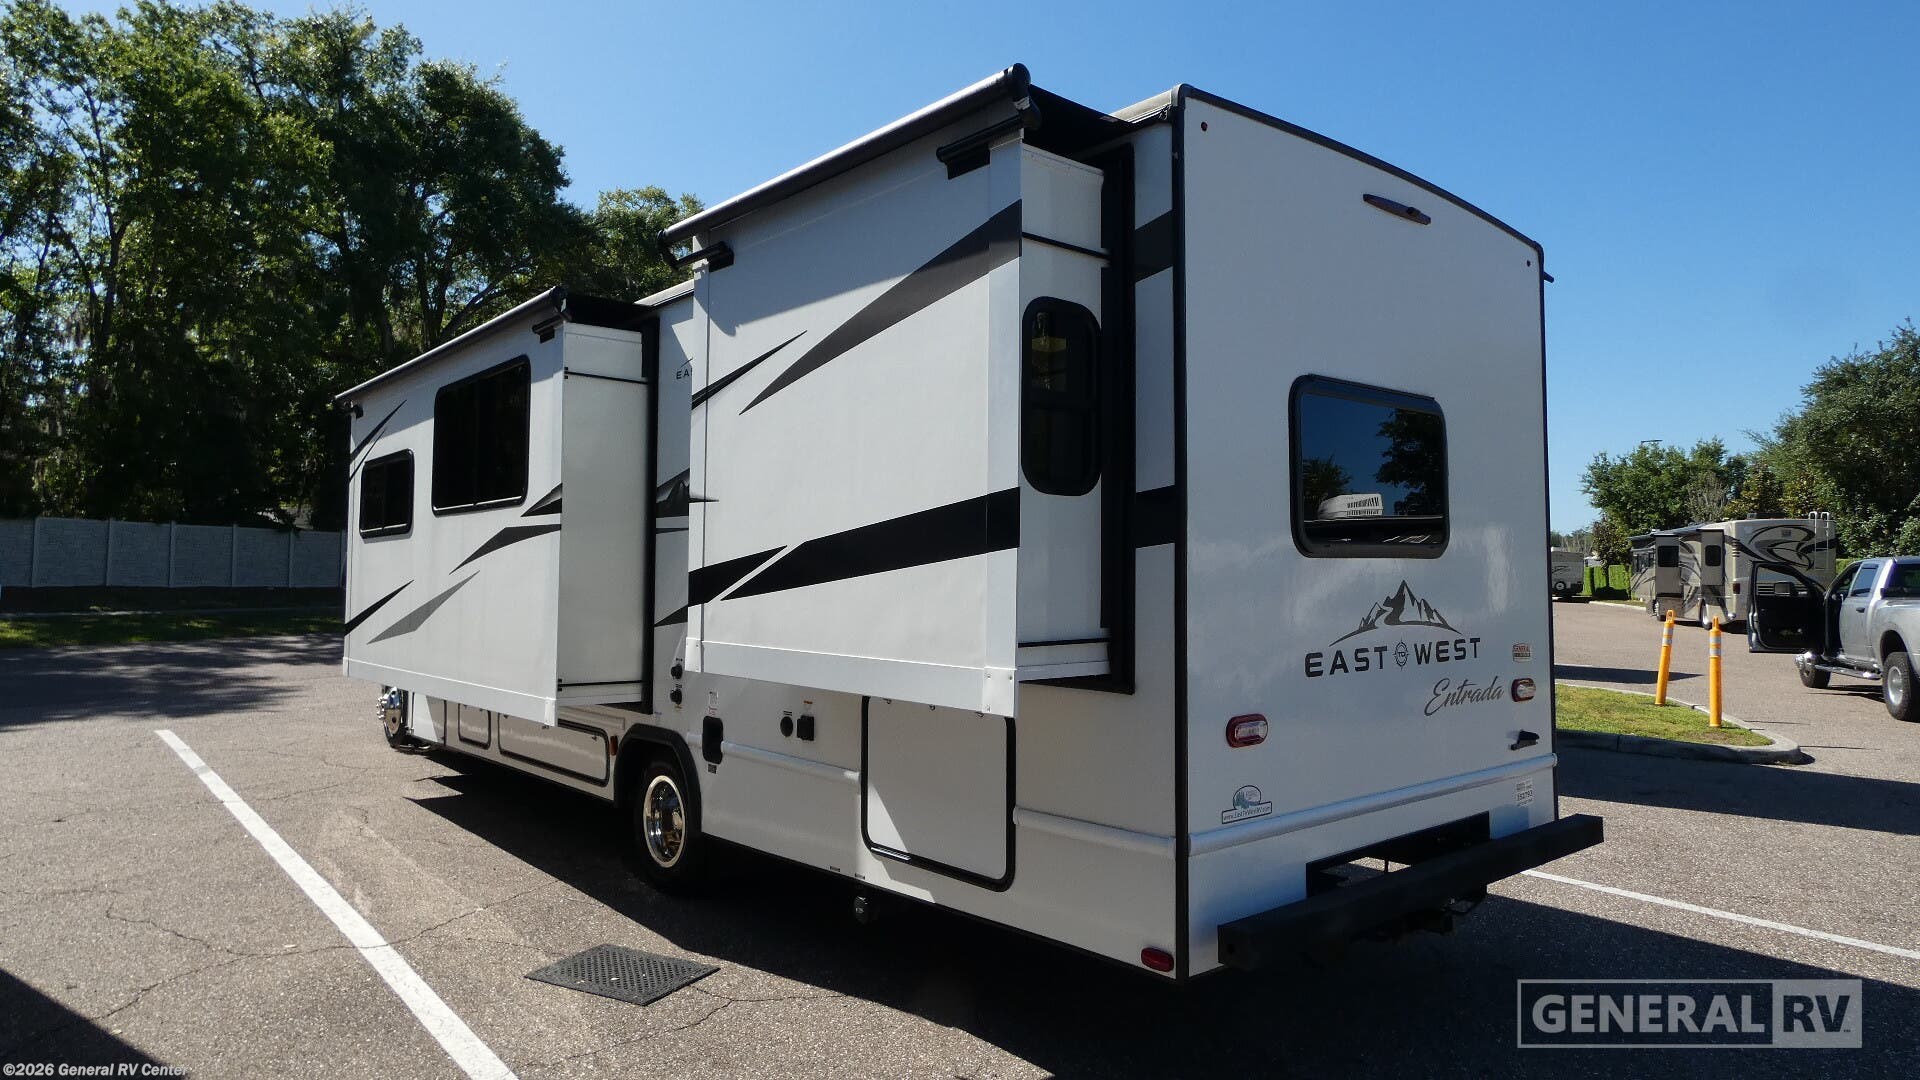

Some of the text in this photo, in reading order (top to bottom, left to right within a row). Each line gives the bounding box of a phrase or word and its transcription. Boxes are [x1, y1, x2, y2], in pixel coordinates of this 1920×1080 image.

[676, 367, 692, 380] EA
[1304, 646, 1388, 678] EAST
[1413, 637, 1481, 666] WEST
[1424, 676, 1505, 717] Entrada
